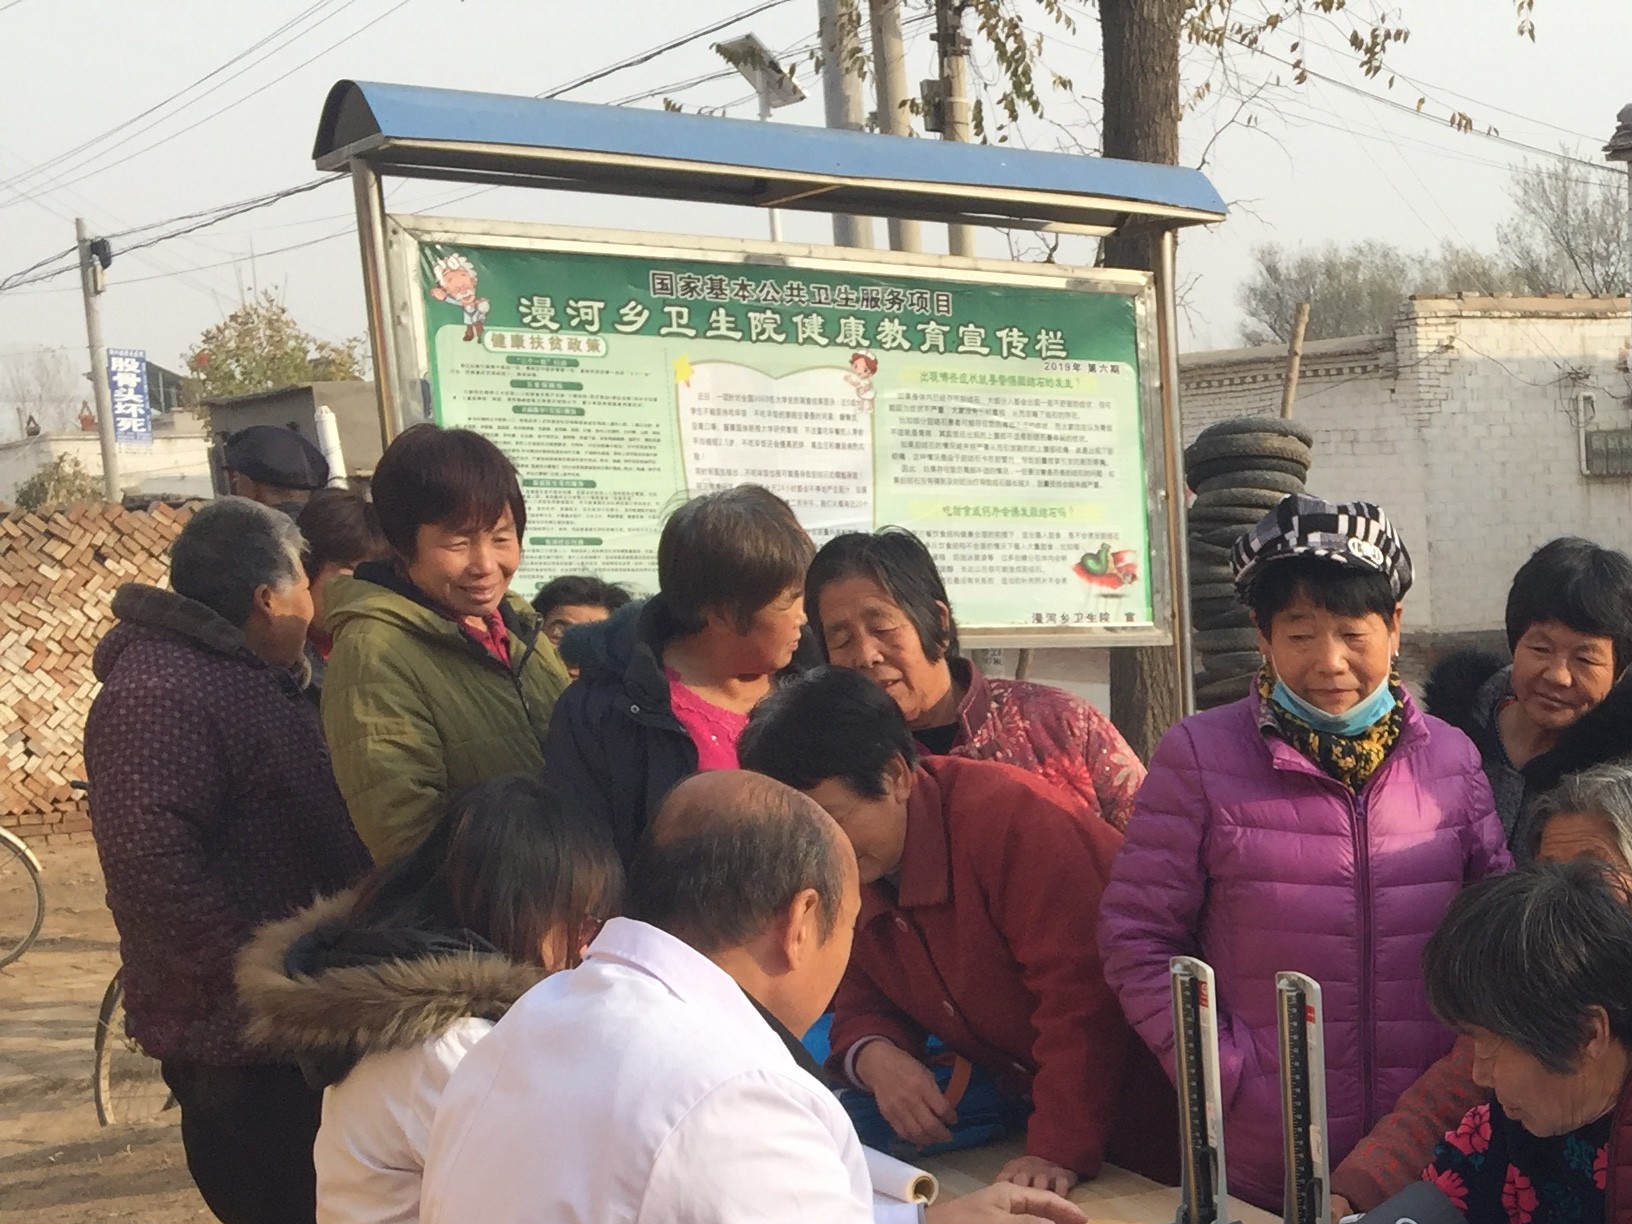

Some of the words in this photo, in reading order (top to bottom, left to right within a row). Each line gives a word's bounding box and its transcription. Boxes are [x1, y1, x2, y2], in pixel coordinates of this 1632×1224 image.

[651, 272, 952, 316] 国家基本公共卫生服务项目
[491, 333, 601, 354] 健康扶贫政策
[519, 296, 1068, 359] 漫河乡卫生院健康教育宣传栏
[1044, 362, 1081, 372] 2019年
[1088, 363, 1120, 374] 第六期
[110, 357, 147, 432] 股骨头坏死
[1032, 612, 1111, 624] 漫河乡卫生院
